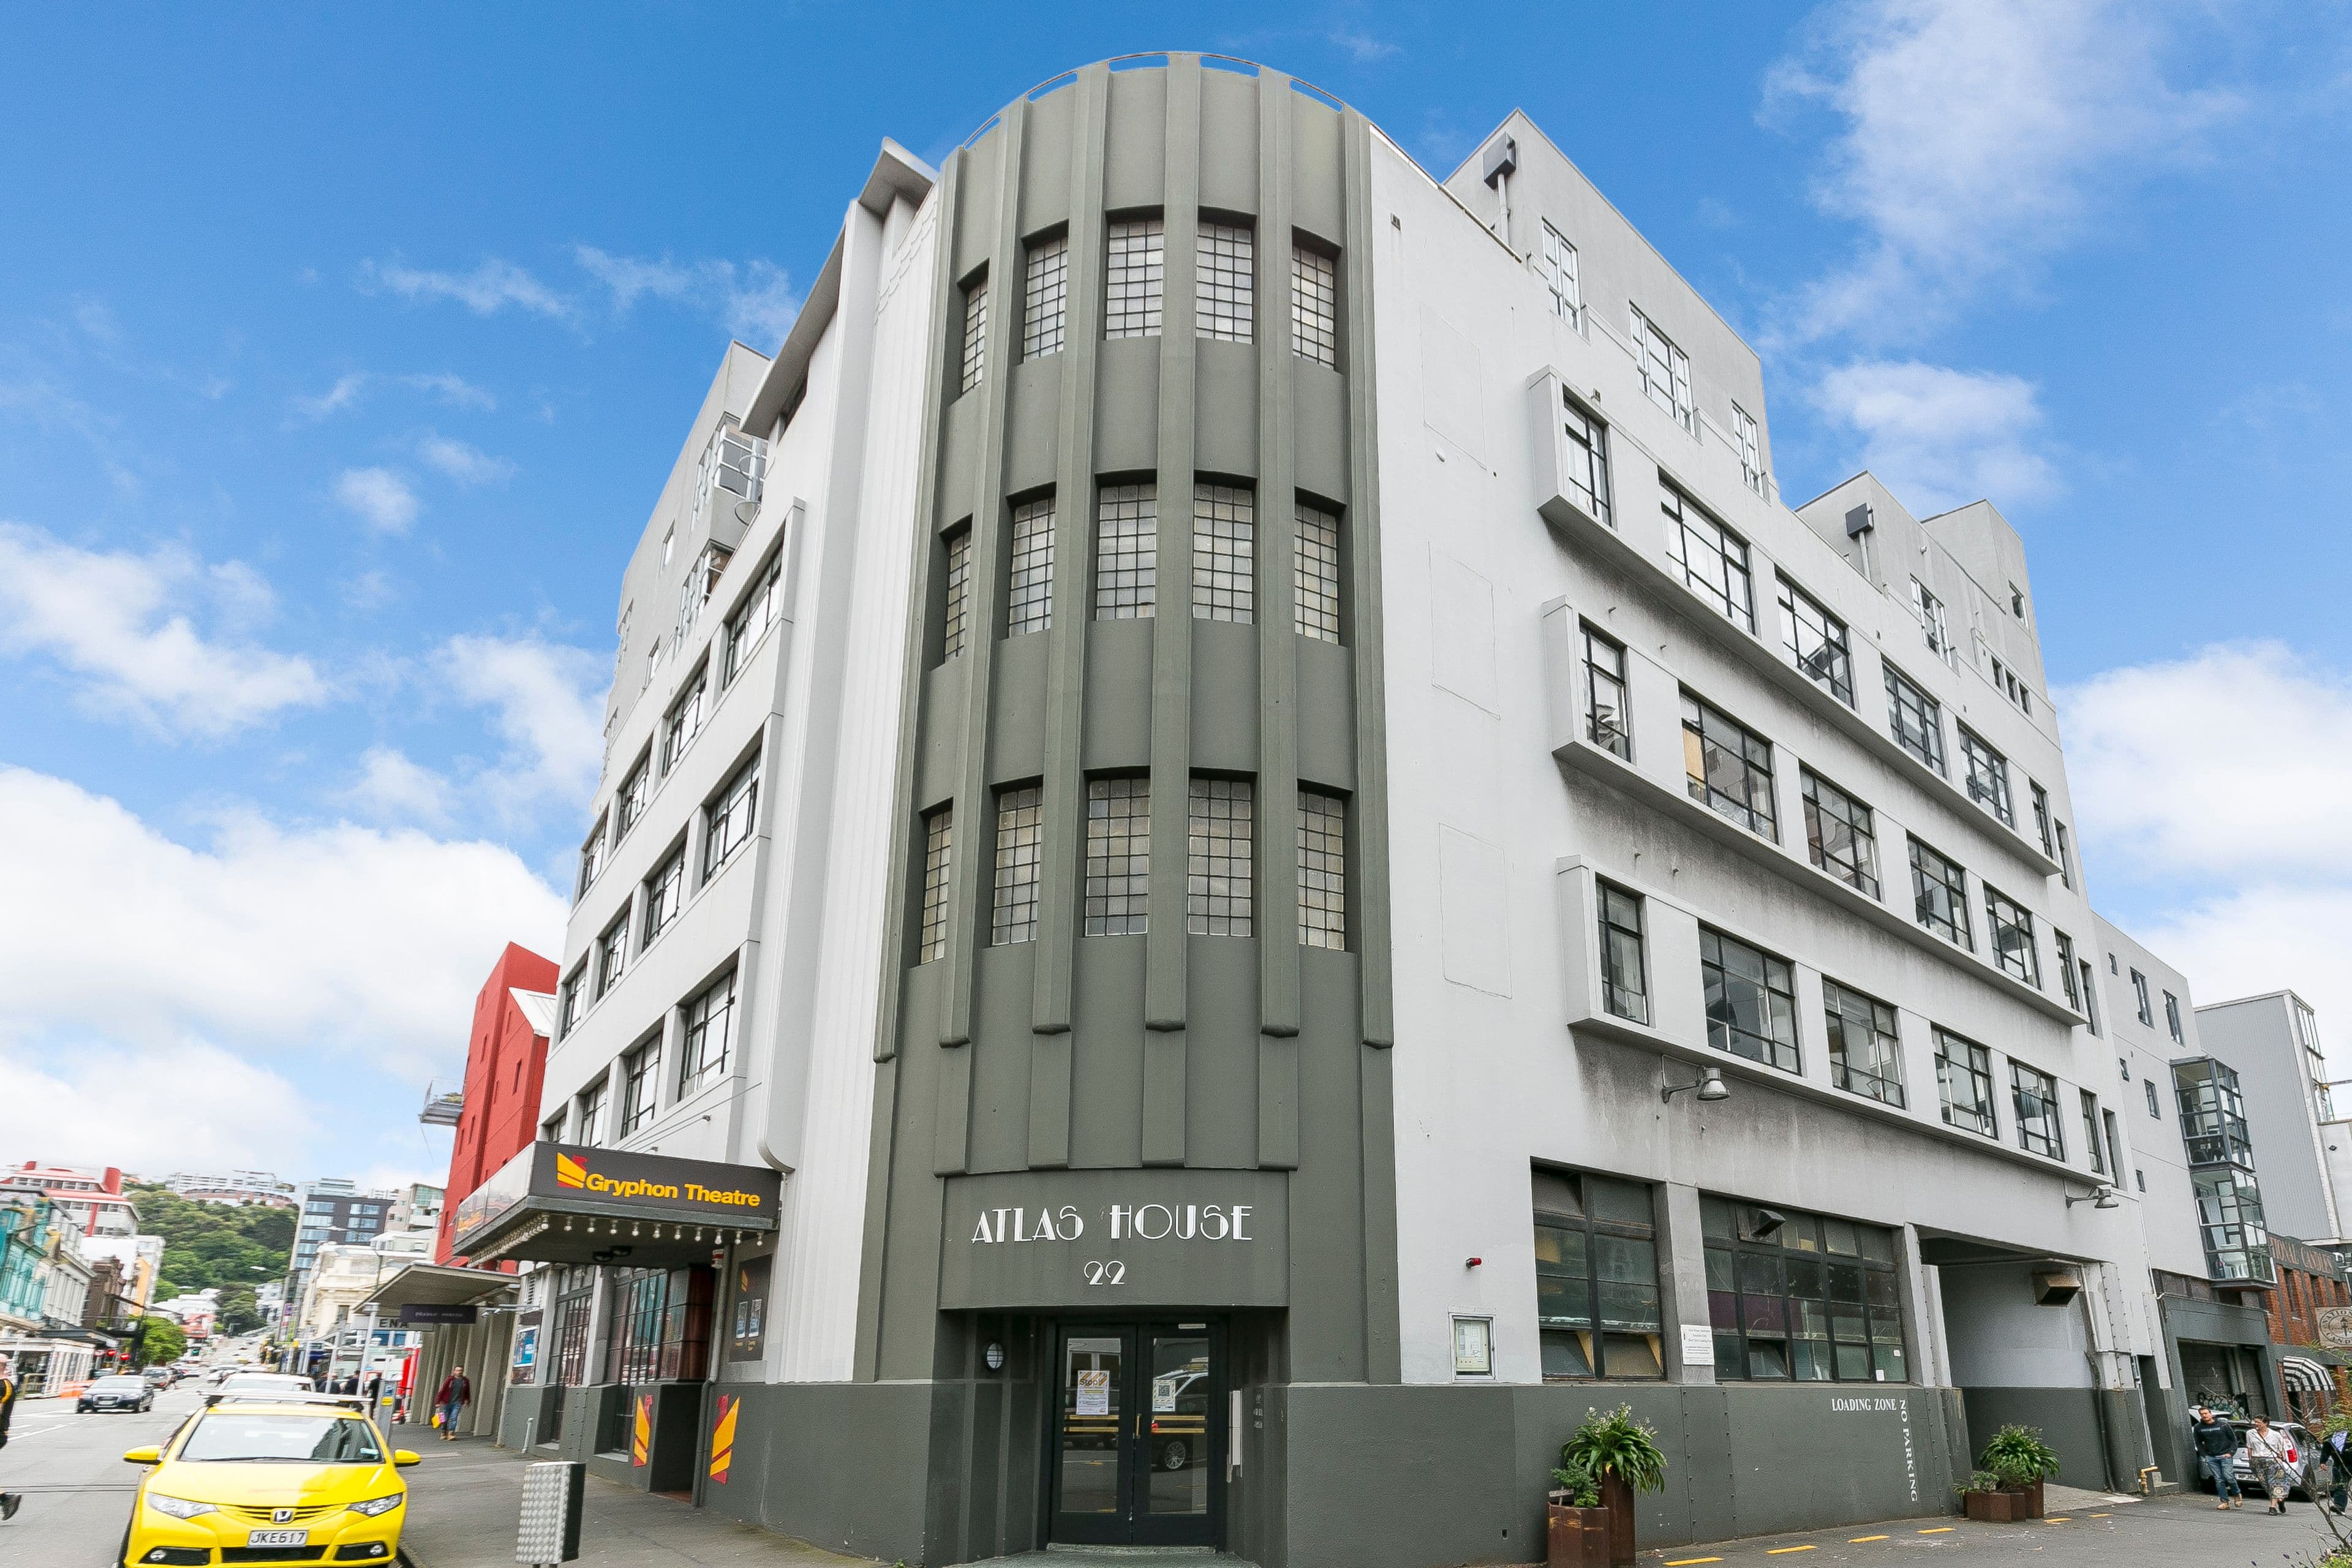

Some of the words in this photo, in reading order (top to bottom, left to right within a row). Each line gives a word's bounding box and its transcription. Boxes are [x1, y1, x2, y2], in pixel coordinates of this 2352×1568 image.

[586, 1173, 678, 1199] Gryphon
[684, 1183, 761, 1207] Theatre
[971, 1205, 1084, 1244] ATLAS
[1109, 1204, 1253, 1241] HOUSE
[1083, 1260, 1126, 1285] 22
[1831, 1398, 1871, 1411] LOADING
[1874, 1398, 1897, 1411] ZONE
[1899, 1400, 1908, 1422] NO
[1902, 1428, 1918, 1502] PARKING
[251, 1532, 306, 1544] JKE617
